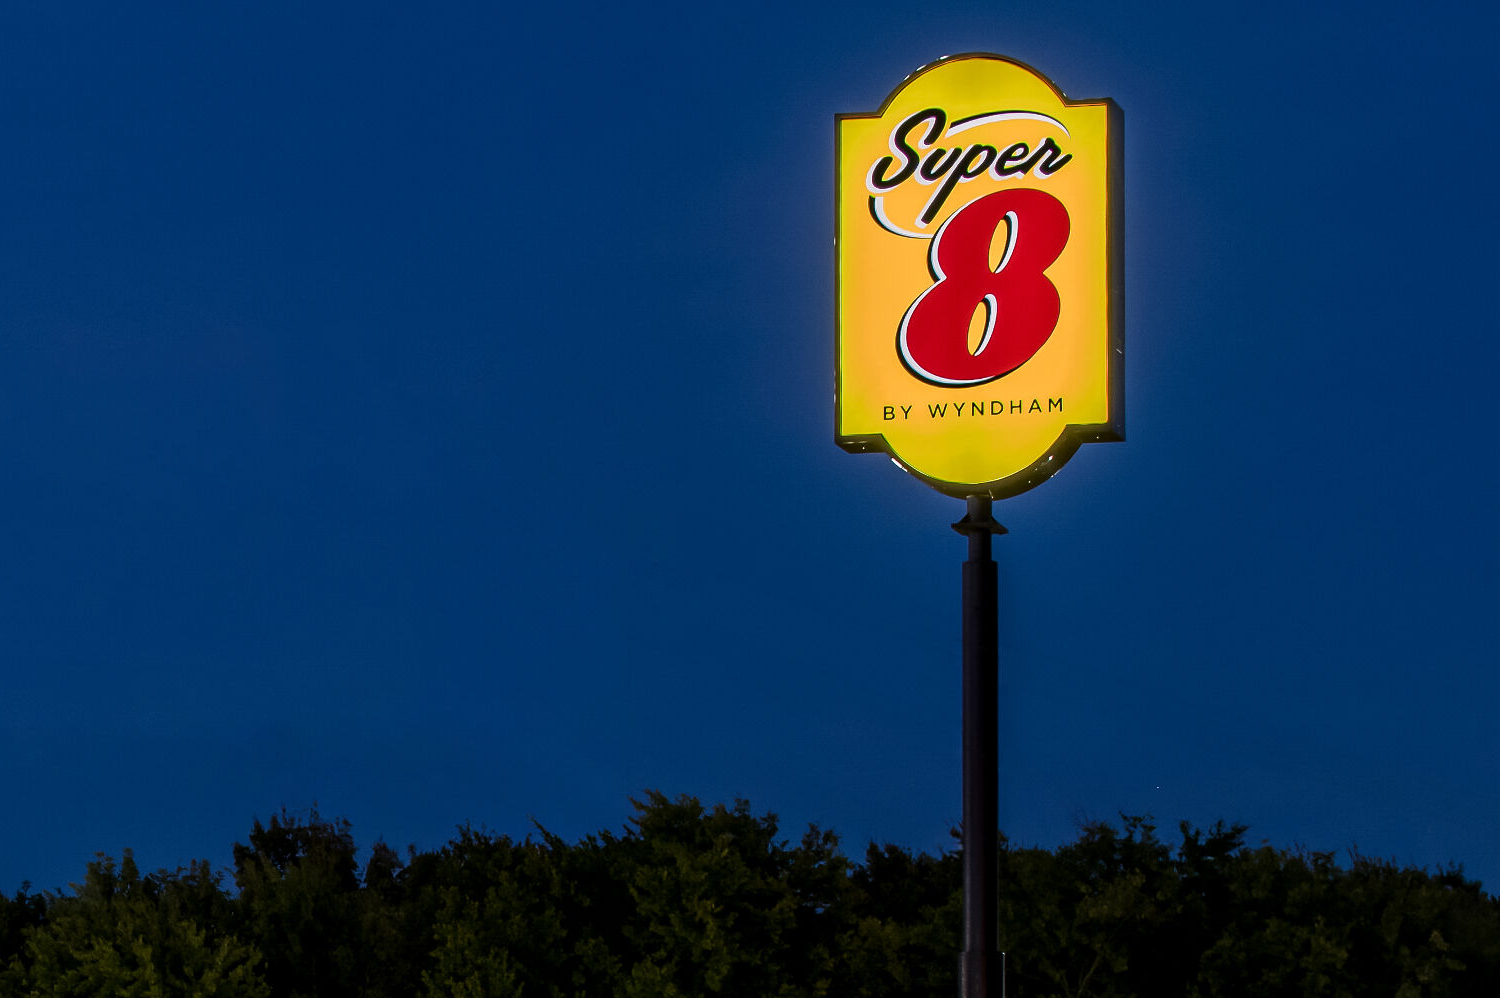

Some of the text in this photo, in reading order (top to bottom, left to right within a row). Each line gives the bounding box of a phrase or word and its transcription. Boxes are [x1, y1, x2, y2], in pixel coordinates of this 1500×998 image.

[866, 108, 1073, 228] Super
[896, 188, 1071, 389] 8
[883, 397, 1063, 421] BY WYNDHAM
